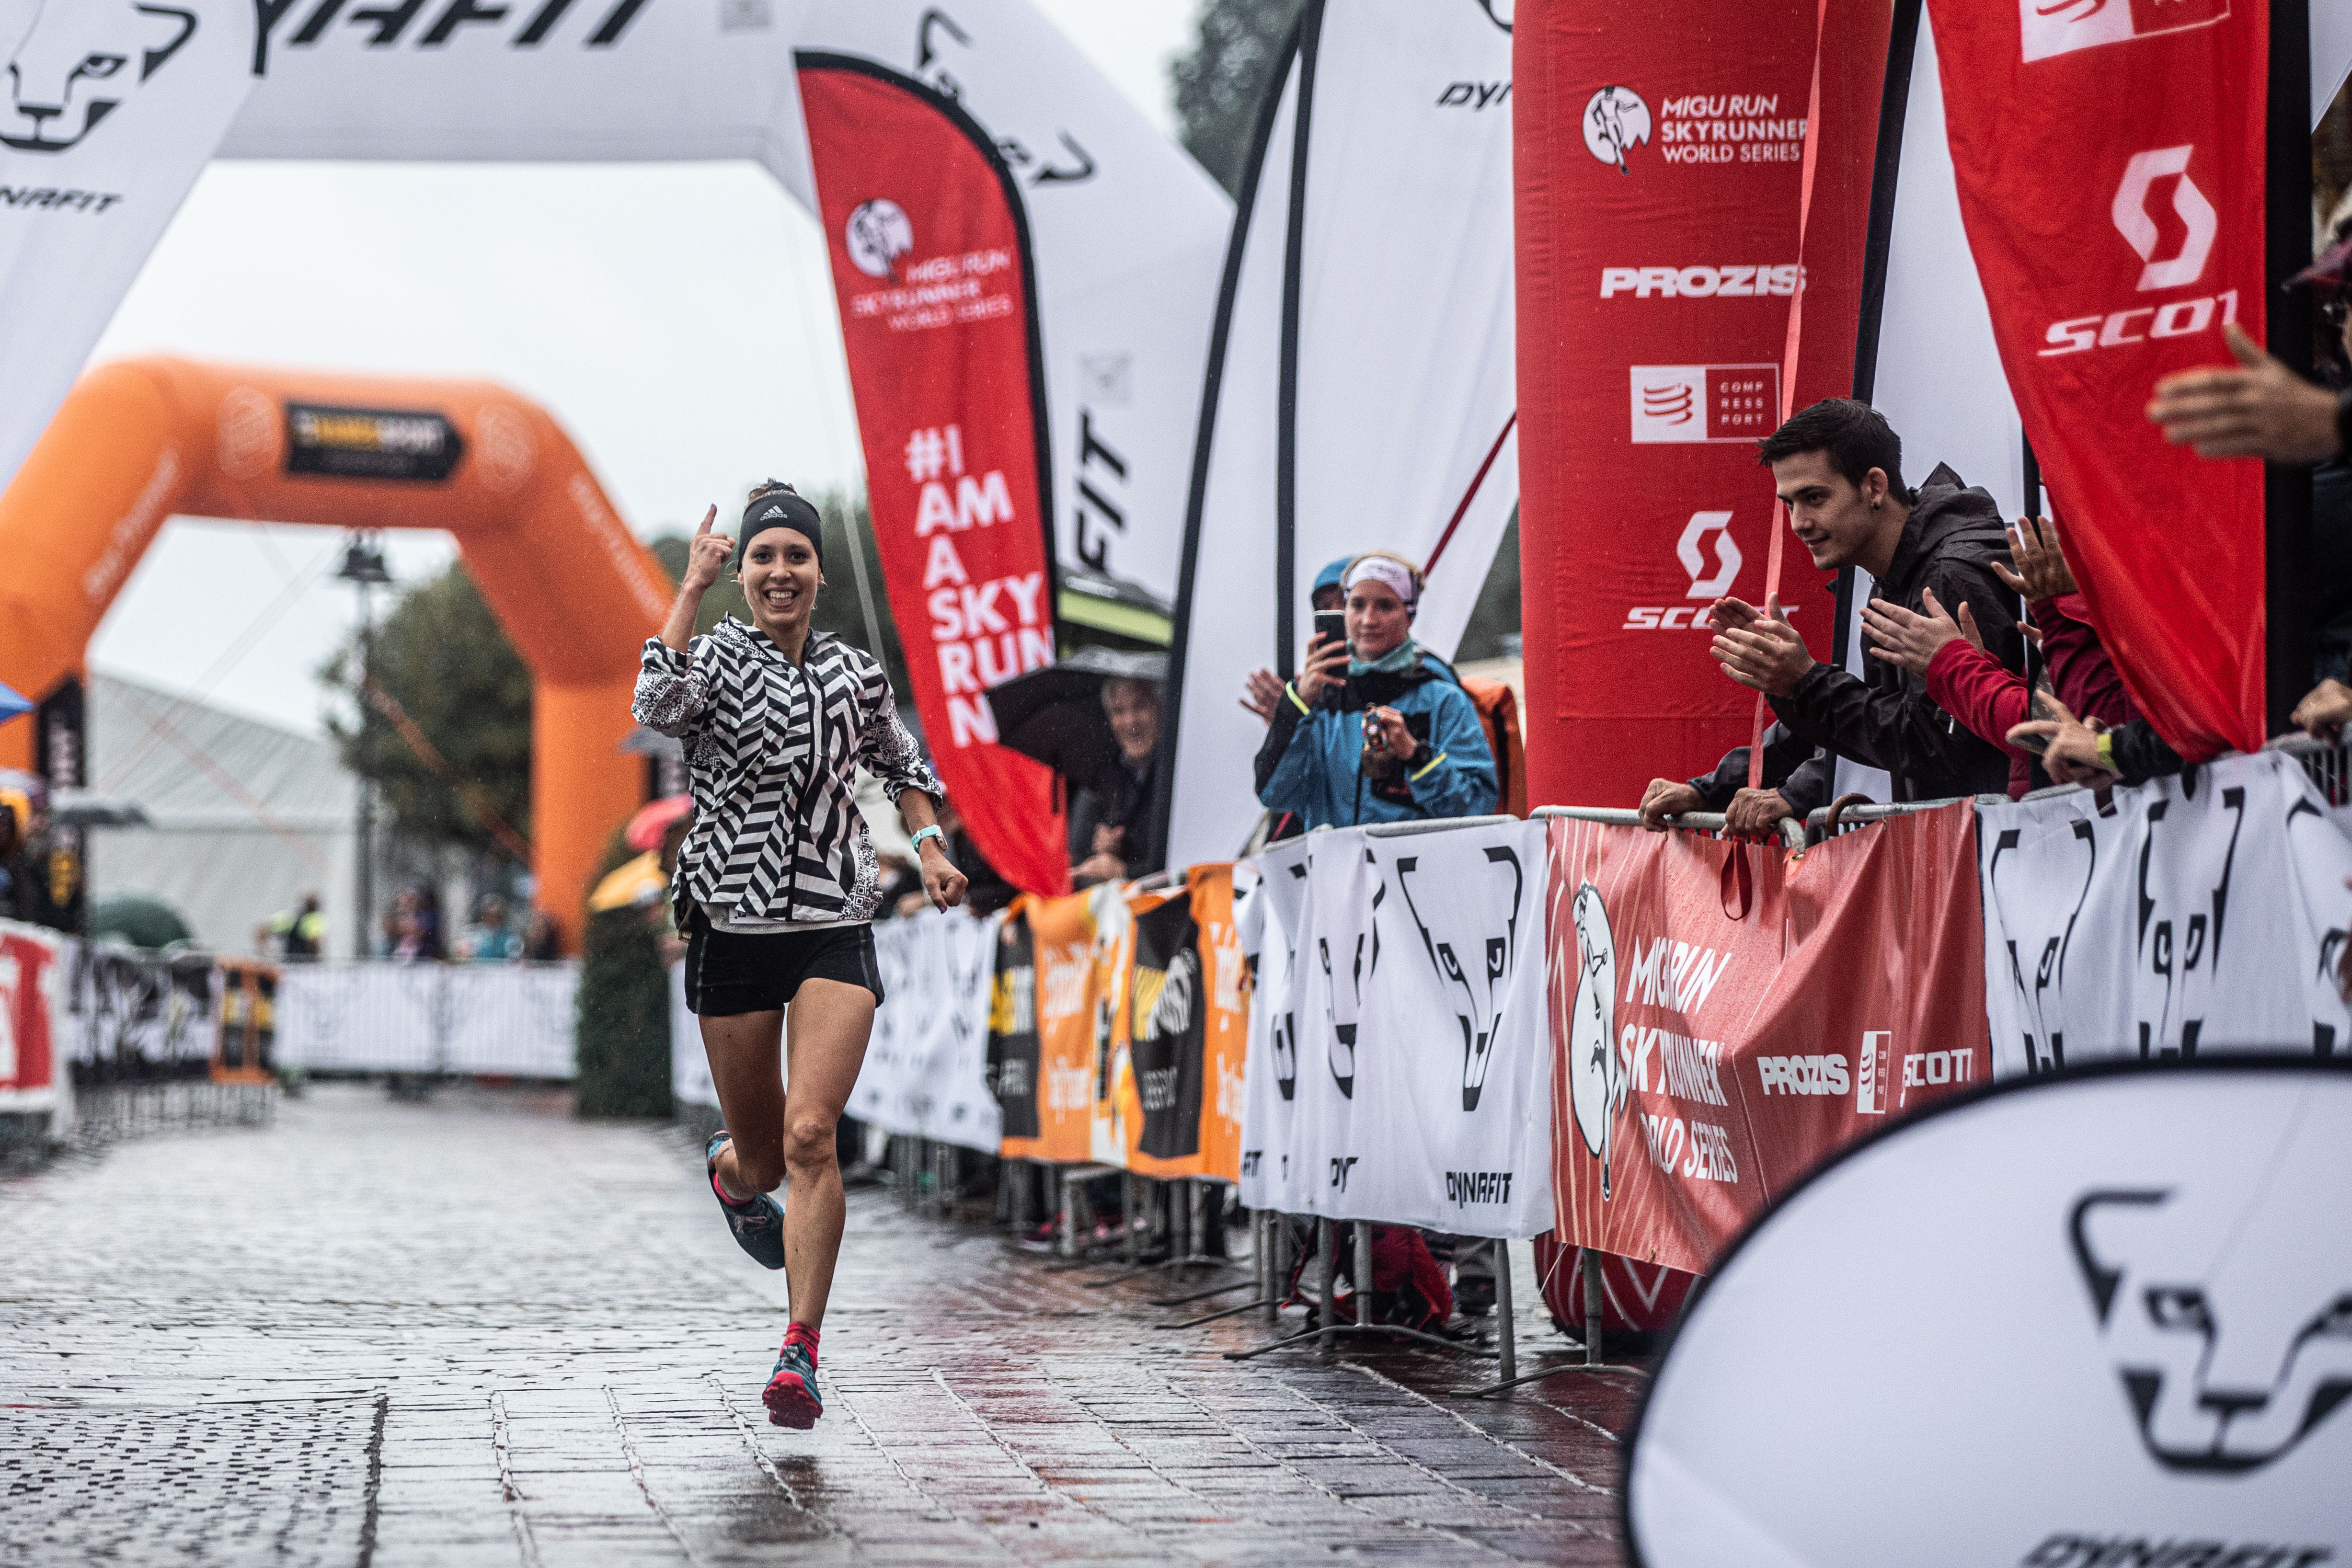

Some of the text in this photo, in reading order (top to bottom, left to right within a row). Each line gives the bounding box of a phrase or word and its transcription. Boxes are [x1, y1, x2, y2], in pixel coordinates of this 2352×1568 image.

[1661, 93, 1778, 119] MIGU RUN
[1661, 142, 1800, 164] WORLD SERIES
[1600, 264, 1807, 299] PROZIS
[1720, 381, 1763, 393] COMP
[1721, 397, 1764, 409] RESS
[1721, 413, 1763, 425] PORT
[905, 424, 964, 480] #I
[760, 512, 788, 521] adidas
[916, 470, 1015, 537] AM
[923, 534, 968, 590] A
[929, 572, 1045, 641] SKY
[1757, 1053, 1850, 1096] PROZIS
[1683, 1120, 1738, 1184] SERIES
[1445, 1171, 1513, 1210] DYNAFIT
